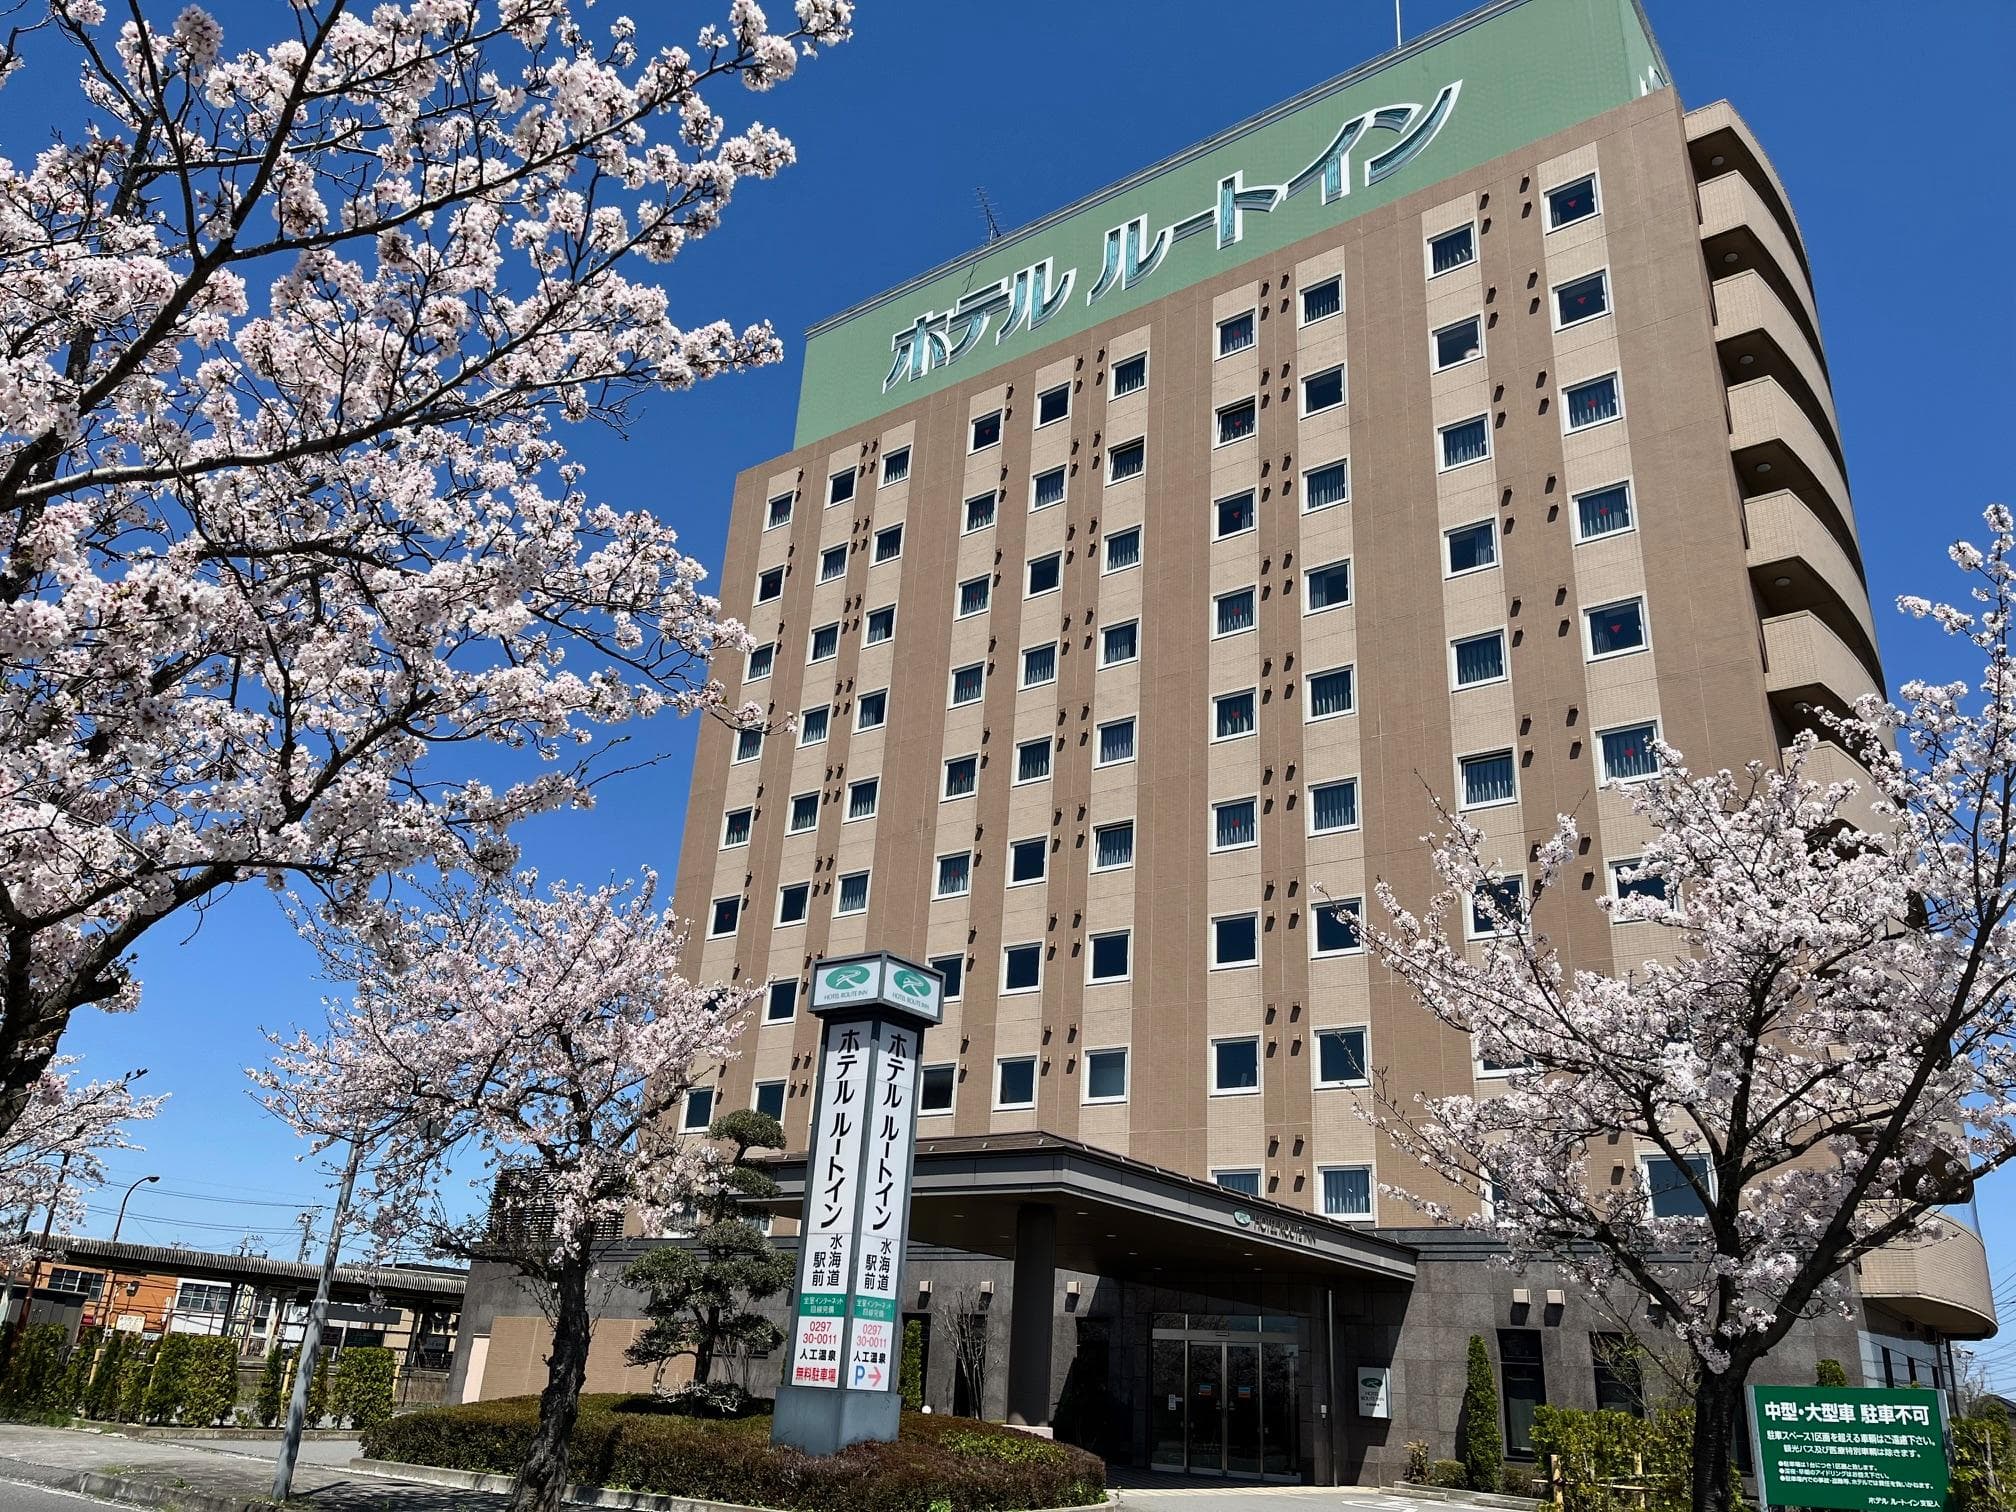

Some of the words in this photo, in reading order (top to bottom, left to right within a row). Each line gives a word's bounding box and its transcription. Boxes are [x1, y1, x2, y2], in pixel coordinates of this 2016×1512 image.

[881, 256, 1077, 394] ホテル
[1086, 79, 1464, 307] ルートイン
[823, 992, 840, 1001] HOTEL
[840, 990, 857, 998] ROUTE
[892, 991, 906, 1002] HOTEL
[832, 1029, 861, 1105] ホテル
[883, 1033, 908, 1109] ホテル
[820, 1112, 852, 1229] ルートイン
[872, 1115, 900, 1231] ルートイン
[811, 1251, 827, 1287] 駅前
[826, 1233, 844, 1287] 水海道
[876, 1238, 893, 1291] 水海道
[863, 1254, 878, 1290] 駅前
[809, 1321, 832, 1332] 0297
[863, 1323, 882, 1335] 0297
[802, 1333, 837, 1345] 30-0011
[856, 1335, 887, 1348] 30-0011
[800, 1348, 837, 1362] 人工温泉
[853, 1350, 886, 1364] 人工温泉
[796, 1366, 836, 1383] 無料駐車場
[854, 1365, 866, 1386] P
[1764, 1401, 1856, 1424] 中型・大型車
[1860, 1404, 1930, 1426] 駐車不可
